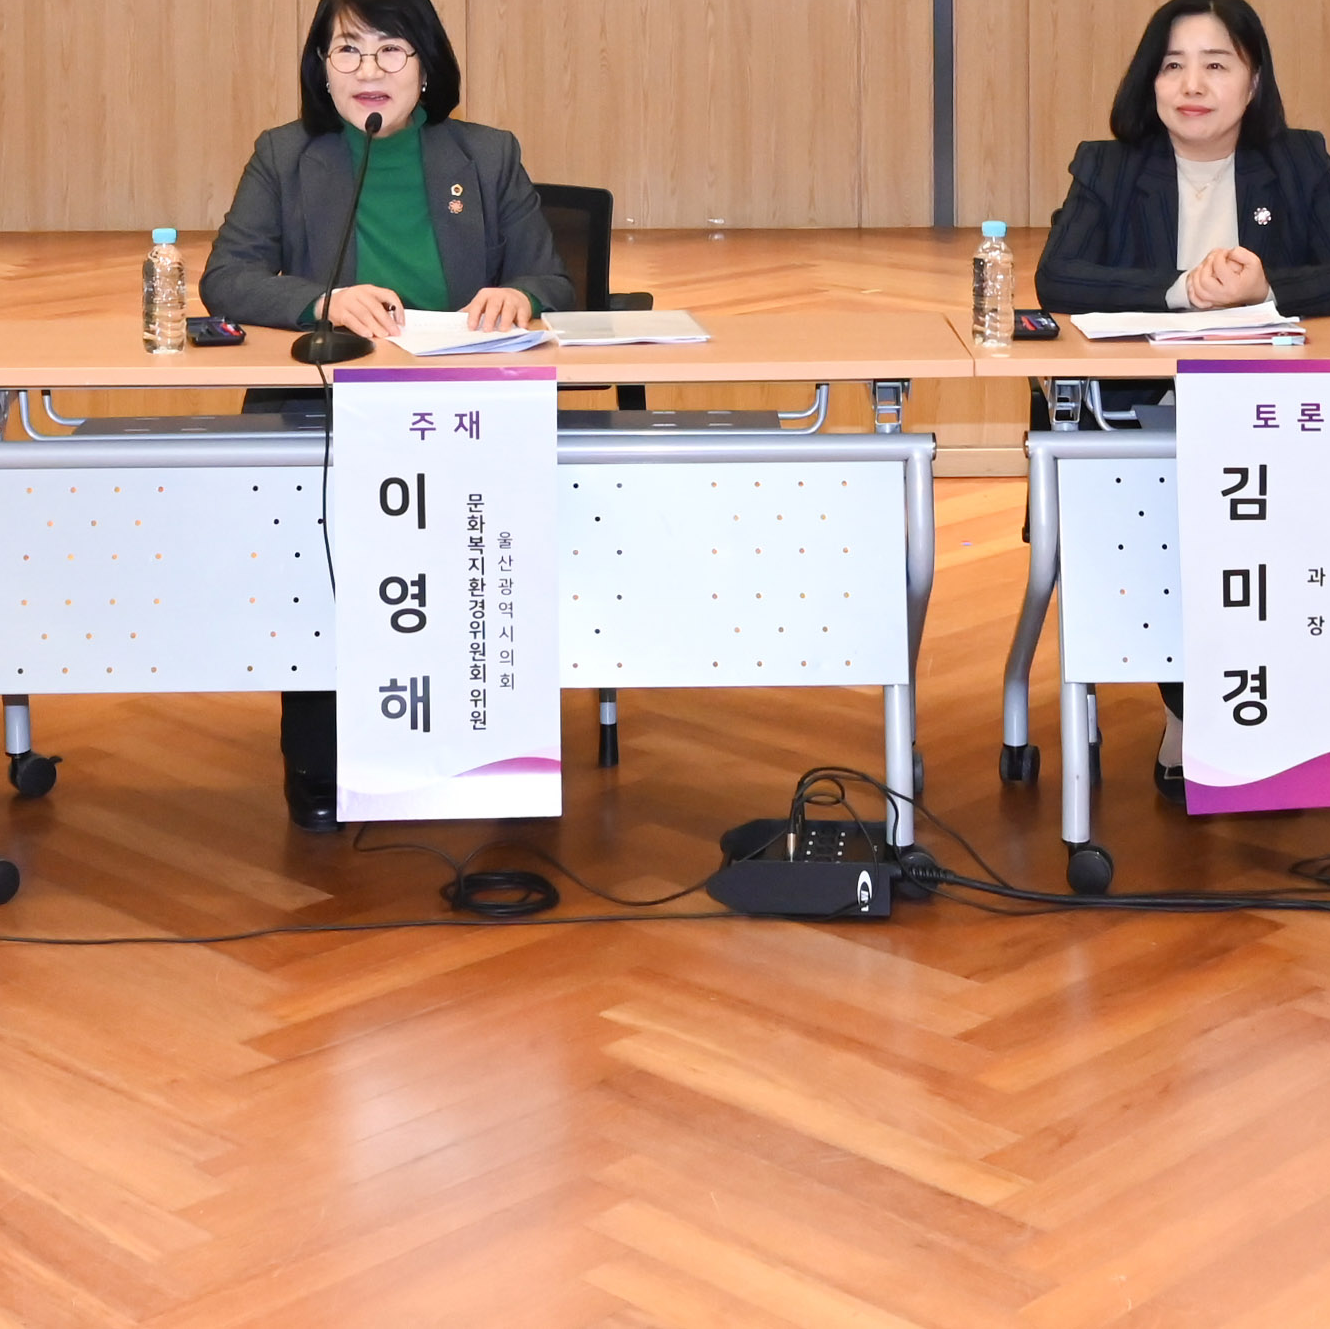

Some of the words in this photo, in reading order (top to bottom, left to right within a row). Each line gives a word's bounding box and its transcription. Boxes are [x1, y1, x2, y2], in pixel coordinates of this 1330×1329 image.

[408, 410, 481, 441] 주재
[1252, 402, 1325, 432] 토론
[378, 472, 432, 733] 이영해
[466, 493, 487, 685] 문화복지환경위원회
[497, 531, 515, 691] 울산광역시의회
[1220, 463, 1268, 727] 김미경
[1306, 566, 1326, 637] 과장
[469, 687, 487, 731] 위원
